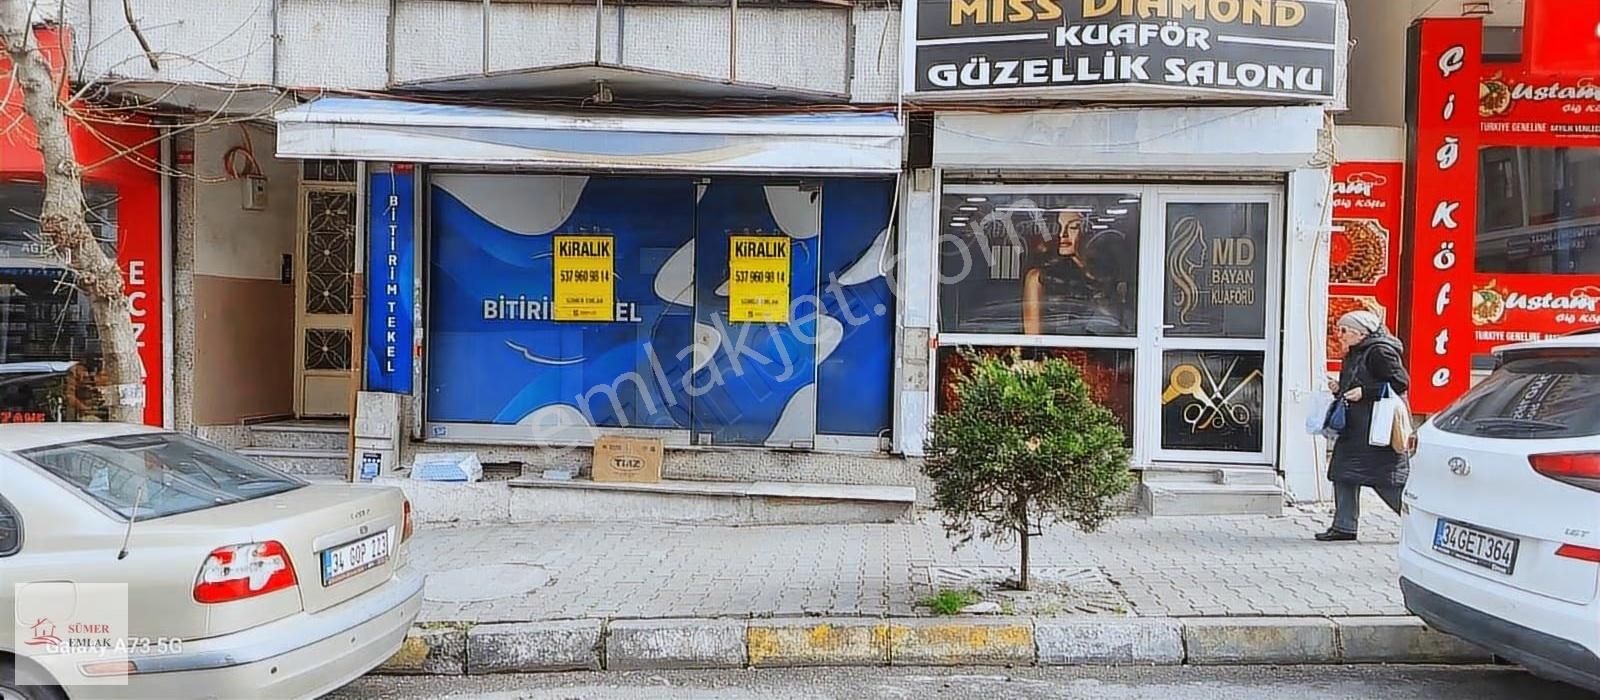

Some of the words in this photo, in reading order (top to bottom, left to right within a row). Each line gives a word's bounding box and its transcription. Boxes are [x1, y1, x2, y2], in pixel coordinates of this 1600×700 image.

[951, 0, 1063, 25] MISS
[1083, 0, 1306, 28] DIAMOND
[1055, 21, 1211, 51] KUAFÖR
[927, 51, 1152, 87] GÜZELLİK
[1164, 60, 1324, 92] SALONU
[1437, 45, 1465, 170] Çiğ
[386, 195, 399, 295] BİTİRİM
[1212, 237, 1255, 266] MD
[1212, 268, 1255, 284] BAYAN
[484, 295, 556, 320] BİTİRİ
[1431, 201, 1461, 388] Köfte
[386, 302, 397, 372] TEKEL
[333, 553, 345, 573] 34
